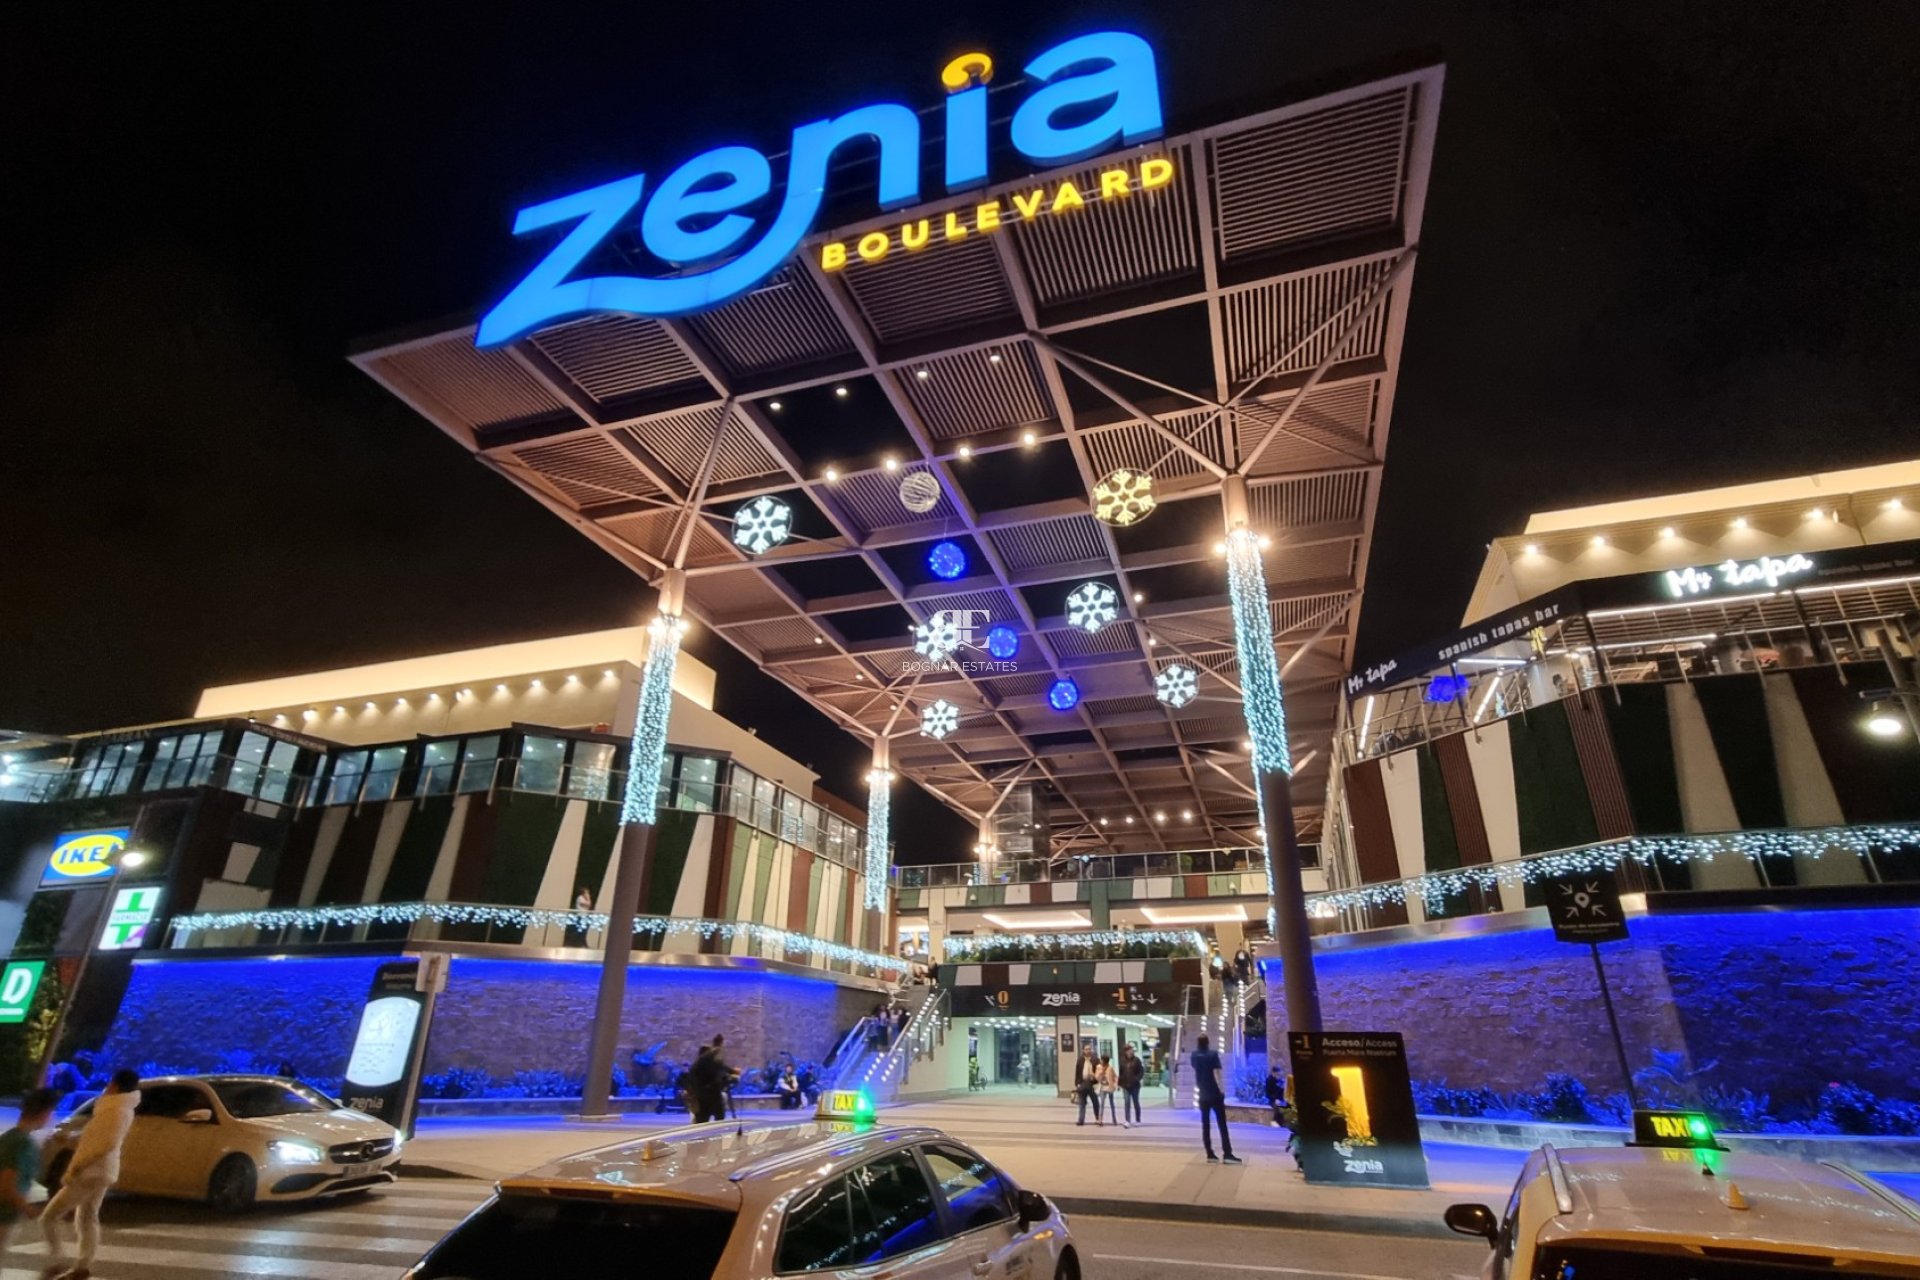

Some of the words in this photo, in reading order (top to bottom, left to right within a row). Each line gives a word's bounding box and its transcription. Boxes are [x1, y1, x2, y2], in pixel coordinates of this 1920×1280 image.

[474, 31, 1164, 348] zenia
[821, 158, 1174, 272] BOULEVARD
[1717, 553, 1814, 587] tapa
[1365, 659, 1398, 683] tapa
[1438, 632, 1488, 661] spanish
[1491, 615, 1530, 639] tapas
[1534, 604, 1560, 622] bar
[2, 967, 33, 1005] D
[1112, 988, 1125, 1003] -1
[997, 991, 1008, 1004] 0
[1042, 992, 1081, 1006] zenia
[350, 1096, 384, 1112] zenia
[1650, 1116, 1692, 1137] TAXI
[1344, 1160, 1384, 1174] zenia
